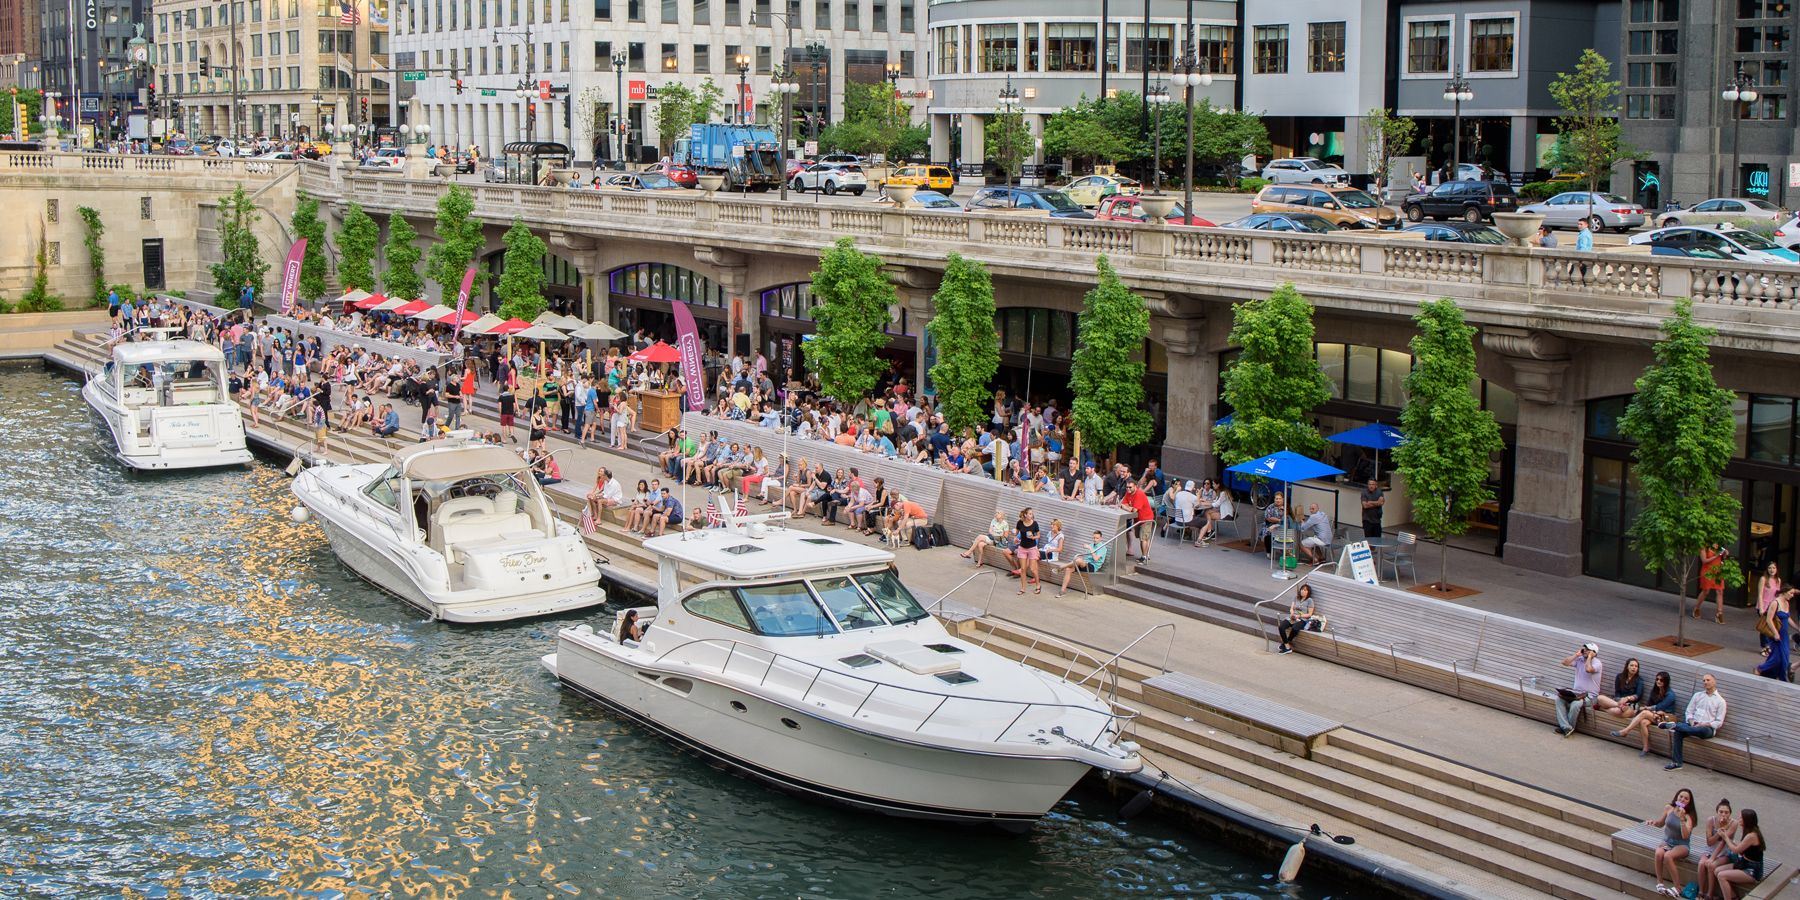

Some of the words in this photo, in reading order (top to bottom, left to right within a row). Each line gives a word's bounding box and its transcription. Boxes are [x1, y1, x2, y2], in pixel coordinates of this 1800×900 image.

[631, 84, 644, 94] mb
[1750, 170, 1768, 187] CATCH
[652, 272, 705, 295] CITY
